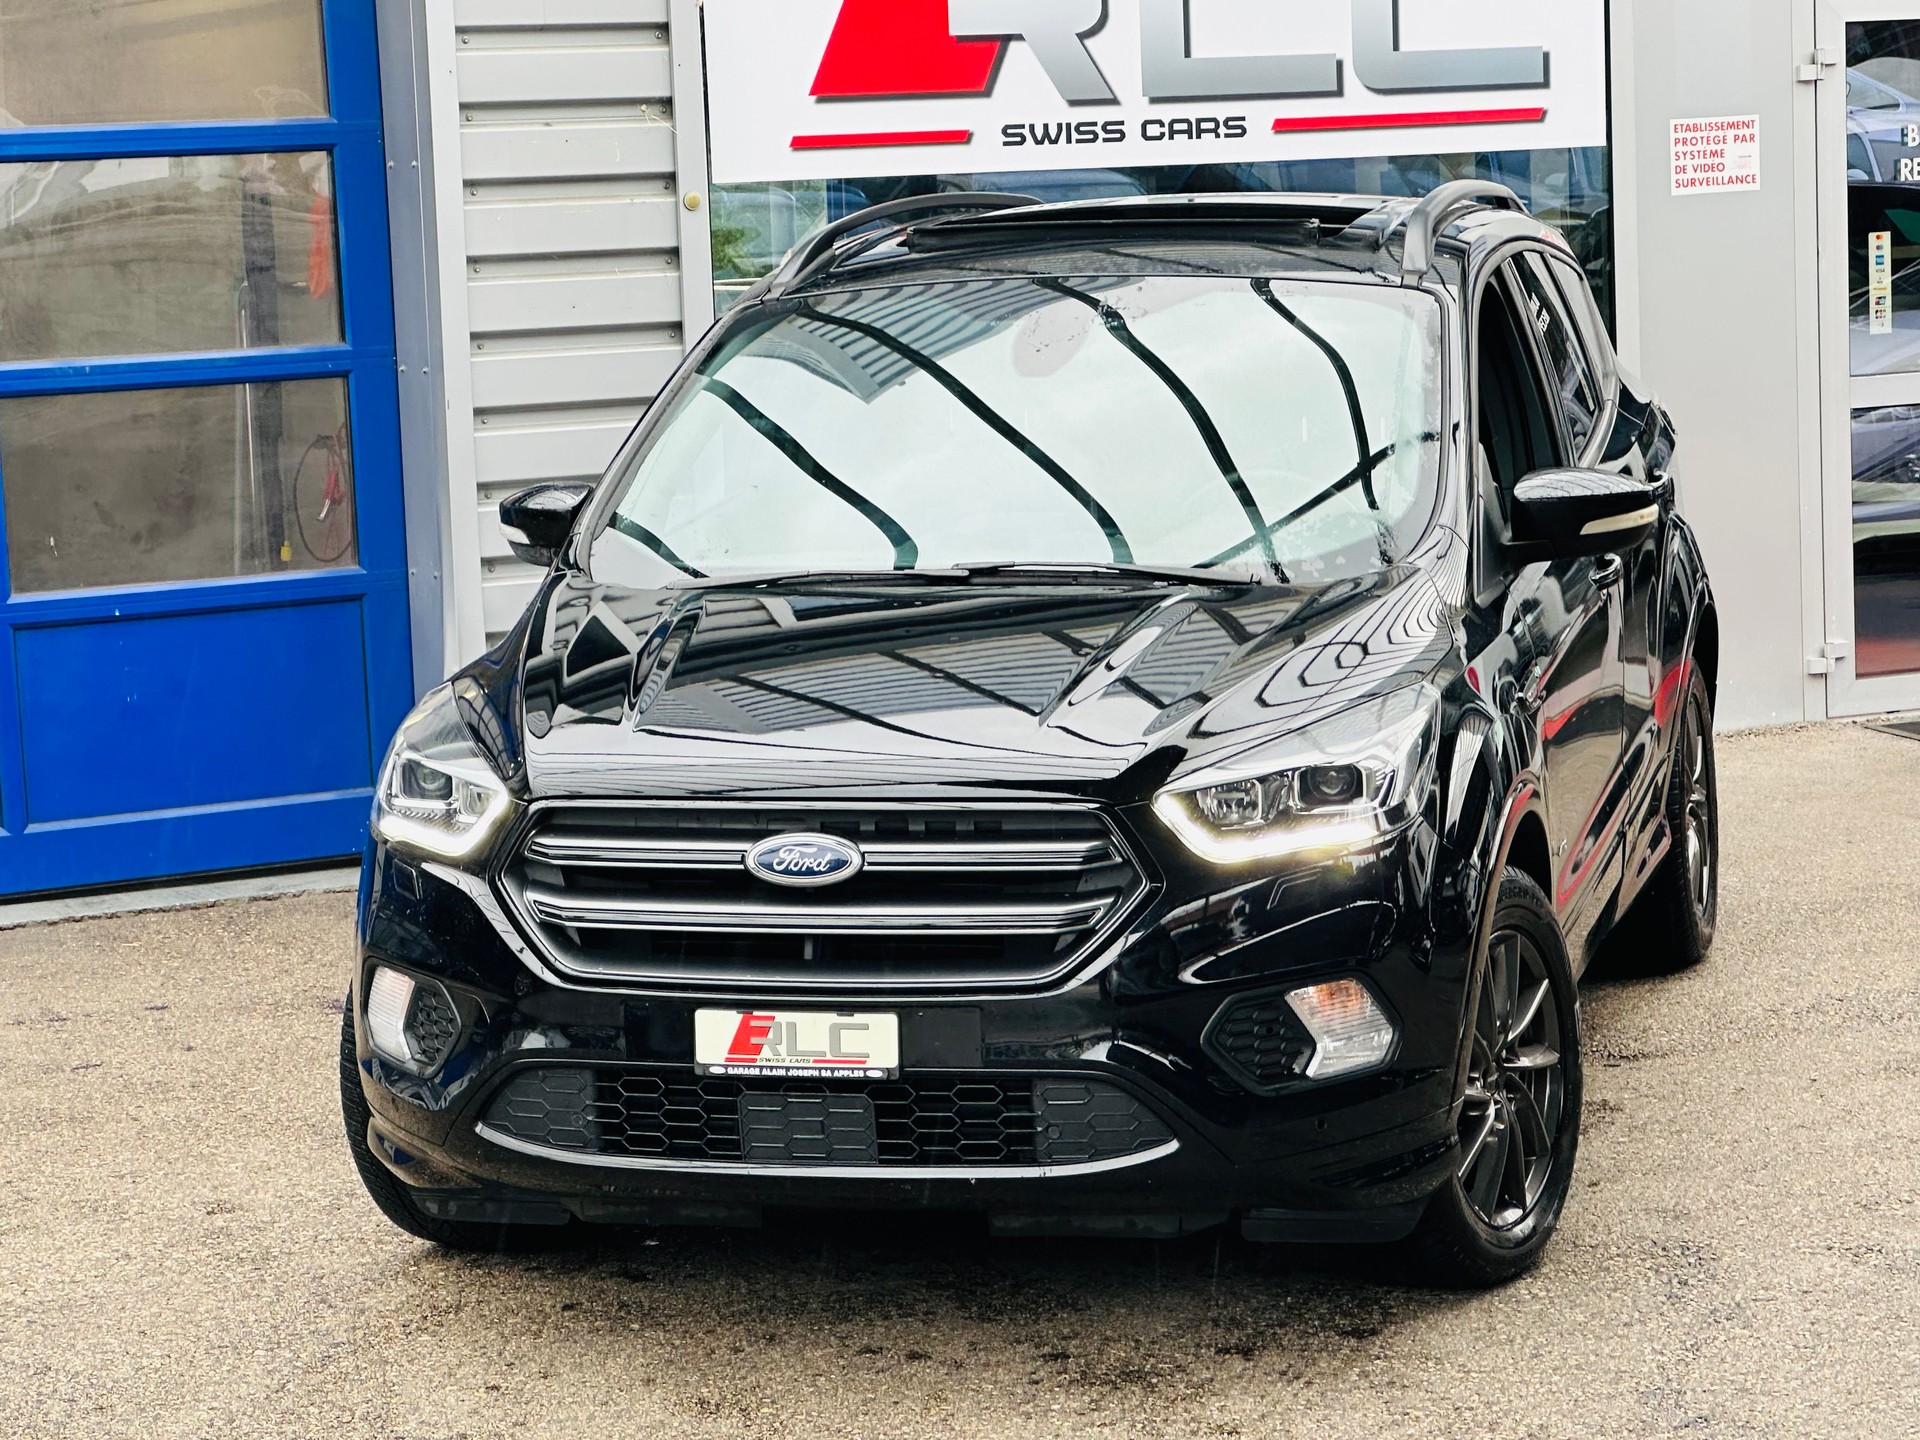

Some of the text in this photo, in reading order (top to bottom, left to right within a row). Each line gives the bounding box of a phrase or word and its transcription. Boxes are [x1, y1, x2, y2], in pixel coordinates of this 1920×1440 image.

[1001, 116, 1247, 147] SWISS CARS
[1673, 119, 1756, 134] ETABLISSEMENT
[1733, 133, 1756, 144] PAR
[1674, 164, 1688, 175] DE
[1675, 174, 1757, 189] SURVEILLANCE
[772, 845, 832, 872] Ford
[727, 1067, 865, 1078] GARAGE ALAIN JOSEPH SA APPLES
